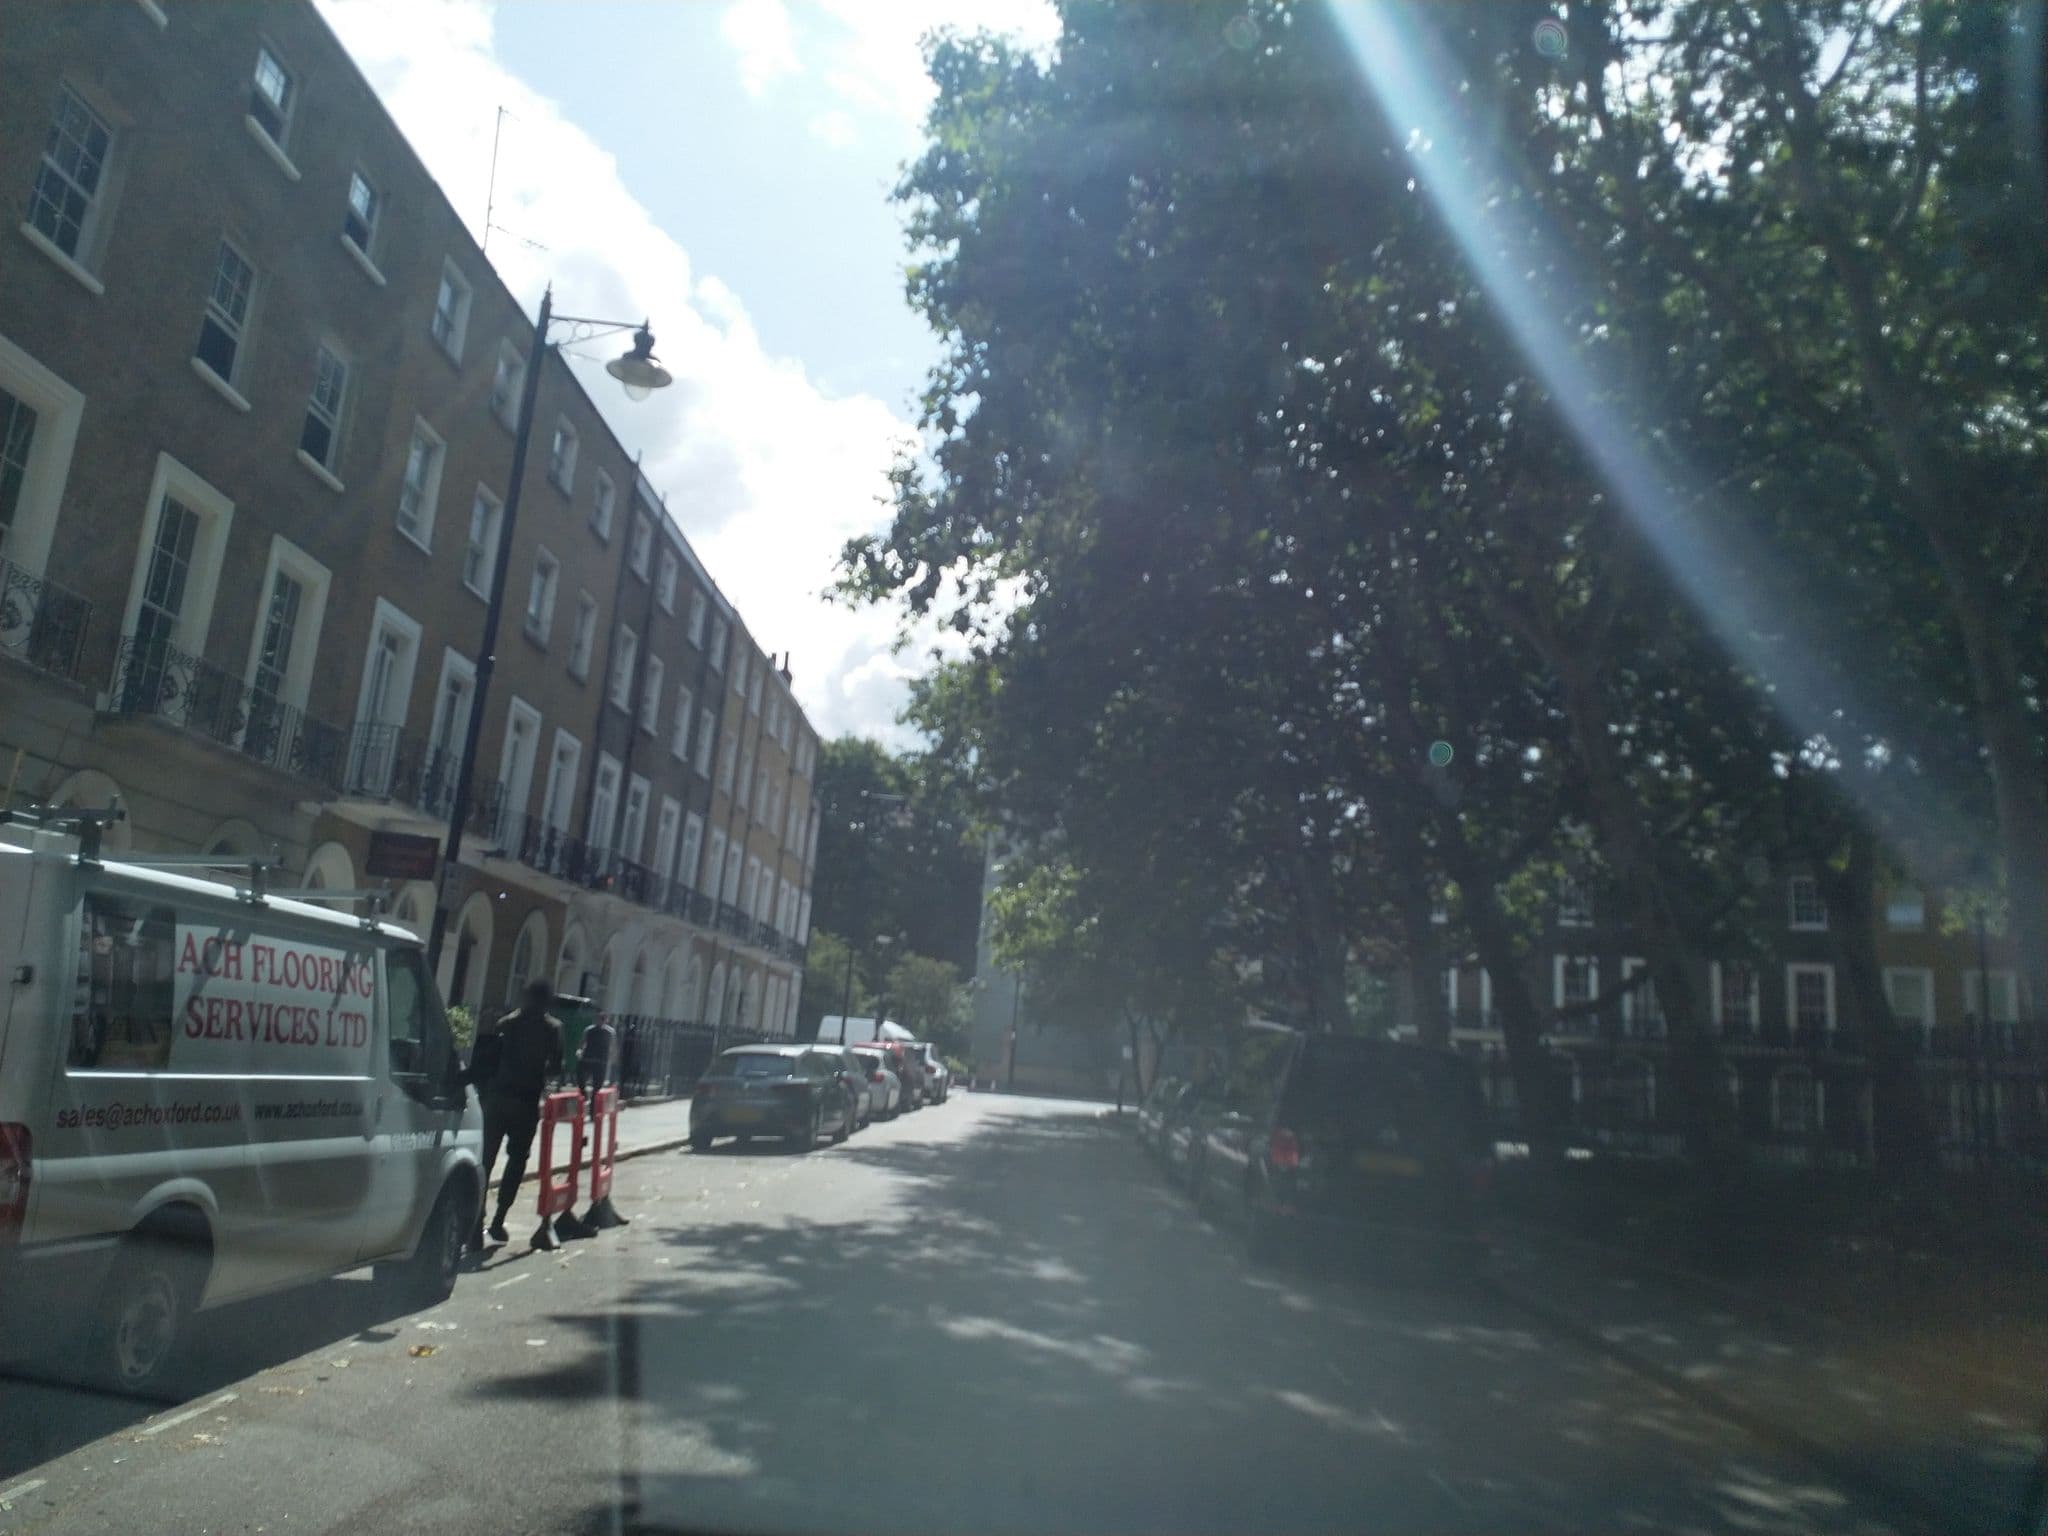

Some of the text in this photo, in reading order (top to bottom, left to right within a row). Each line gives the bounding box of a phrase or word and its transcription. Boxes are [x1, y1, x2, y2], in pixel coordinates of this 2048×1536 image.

[177, 931, 373, 998] ACH FLOORING
[185, 996, 367, 1048] SERVICES LTD
